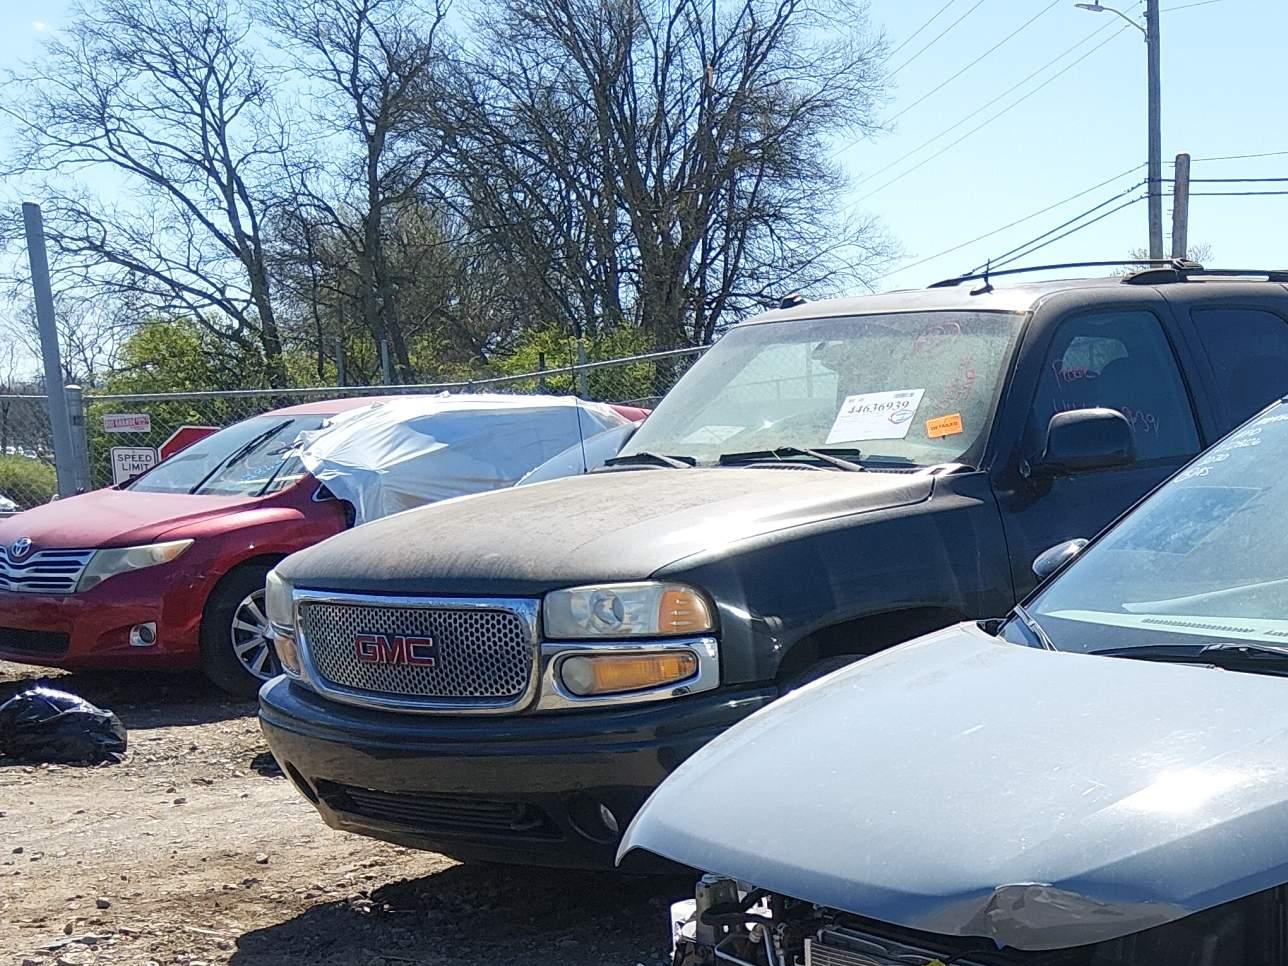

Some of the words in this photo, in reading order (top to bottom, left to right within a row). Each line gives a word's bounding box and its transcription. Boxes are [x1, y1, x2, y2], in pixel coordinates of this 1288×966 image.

[117, 453, 152, 462] SPEED
[122, 463, 150, 471] LIMIT
[355, 633, 435, 667] GMC
